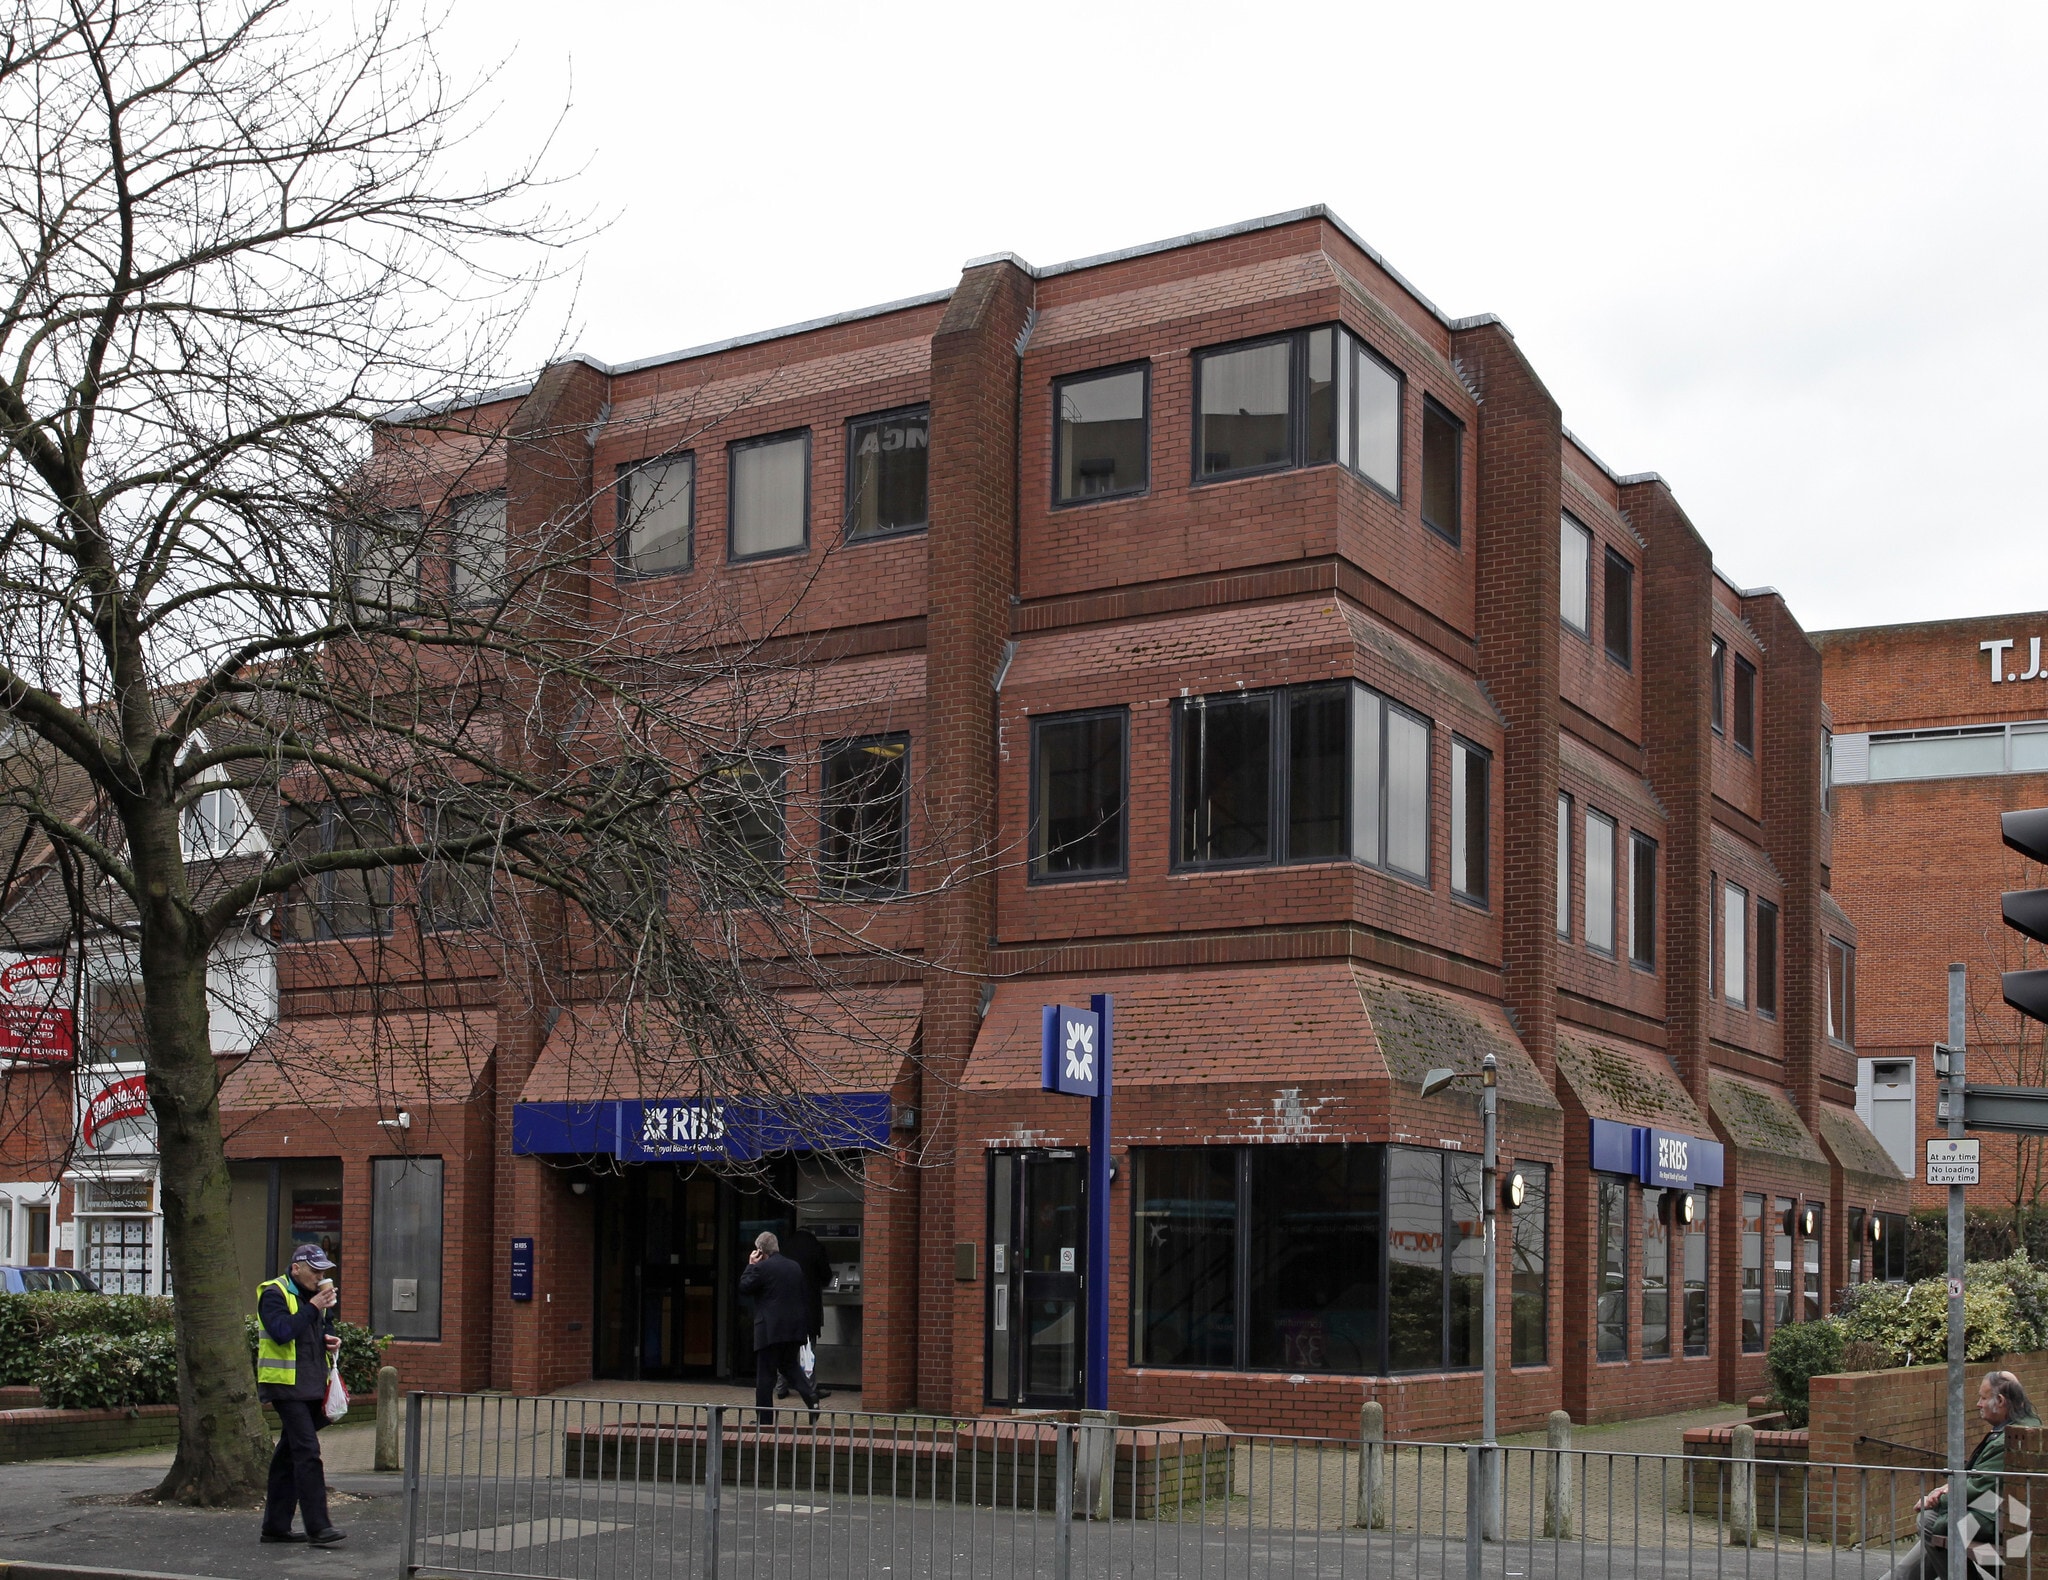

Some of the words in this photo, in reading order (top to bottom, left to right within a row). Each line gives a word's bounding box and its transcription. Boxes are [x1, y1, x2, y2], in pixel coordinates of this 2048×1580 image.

[4, 1010, 63, 1021] ANDLORDS
[10, 1030, 54, 1039] REIRED
[672, 1106, 725, 1141] RBS
[643, 1144, 655, 1153] The
[655, 1144, 672, 1155] oyal
[673, 1144, 688, 1153] Bank
[1669, 1139, 1688, 1171] RBS
[1930, 1153, 1939, 1161] At
[1958, 1153, 1977, 1161] time
[1945, 1166, 1975, 1174] loading
